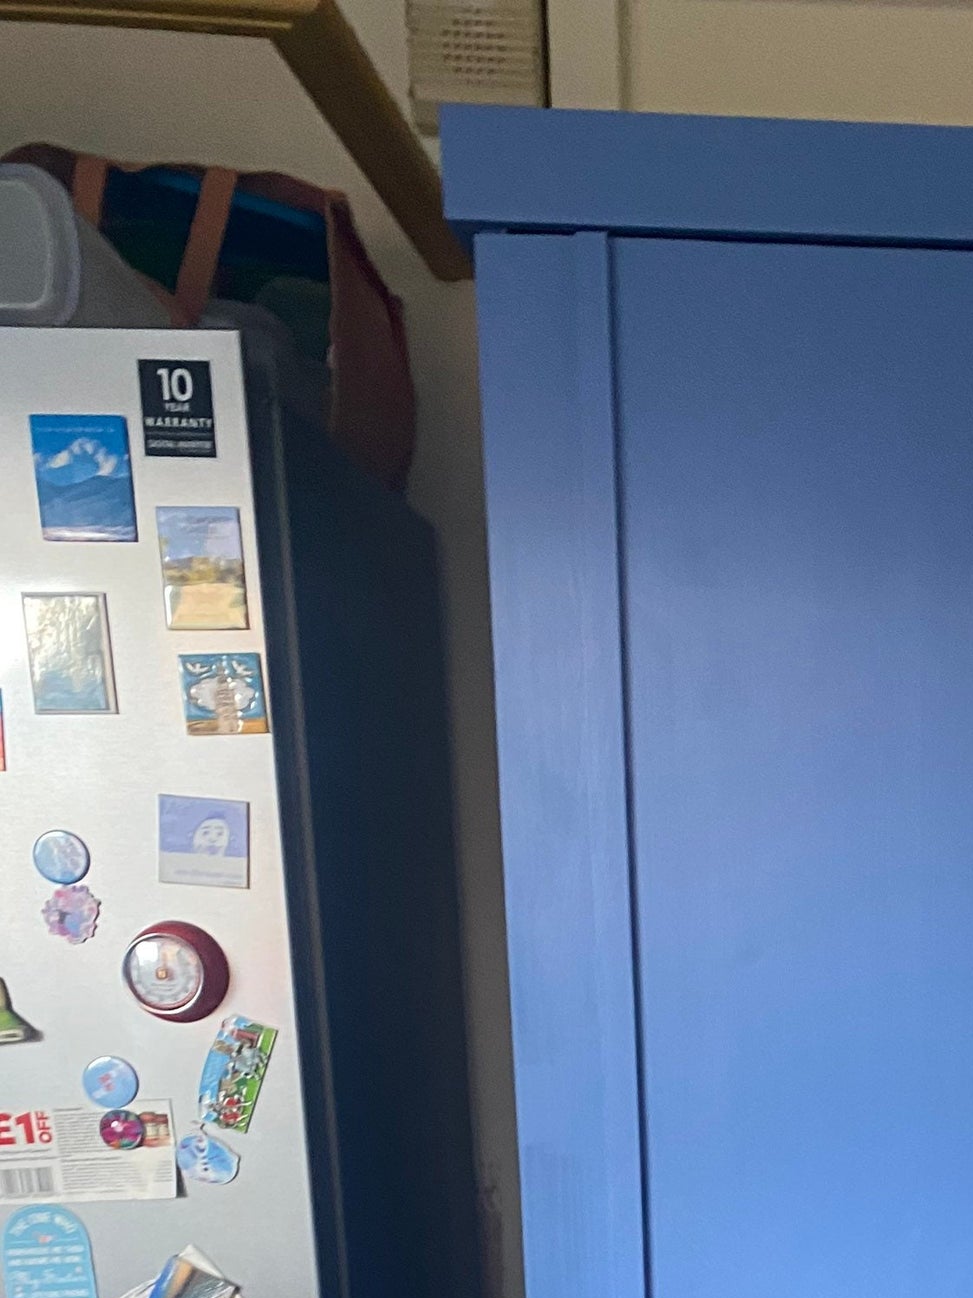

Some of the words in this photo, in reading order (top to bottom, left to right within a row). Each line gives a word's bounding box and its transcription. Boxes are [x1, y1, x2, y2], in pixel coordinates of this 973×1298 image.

[157, 368, 193, 401] 10
[145, 417, 213, 428] WARRANTY
[35, 1111, 53, 1144] OFF
